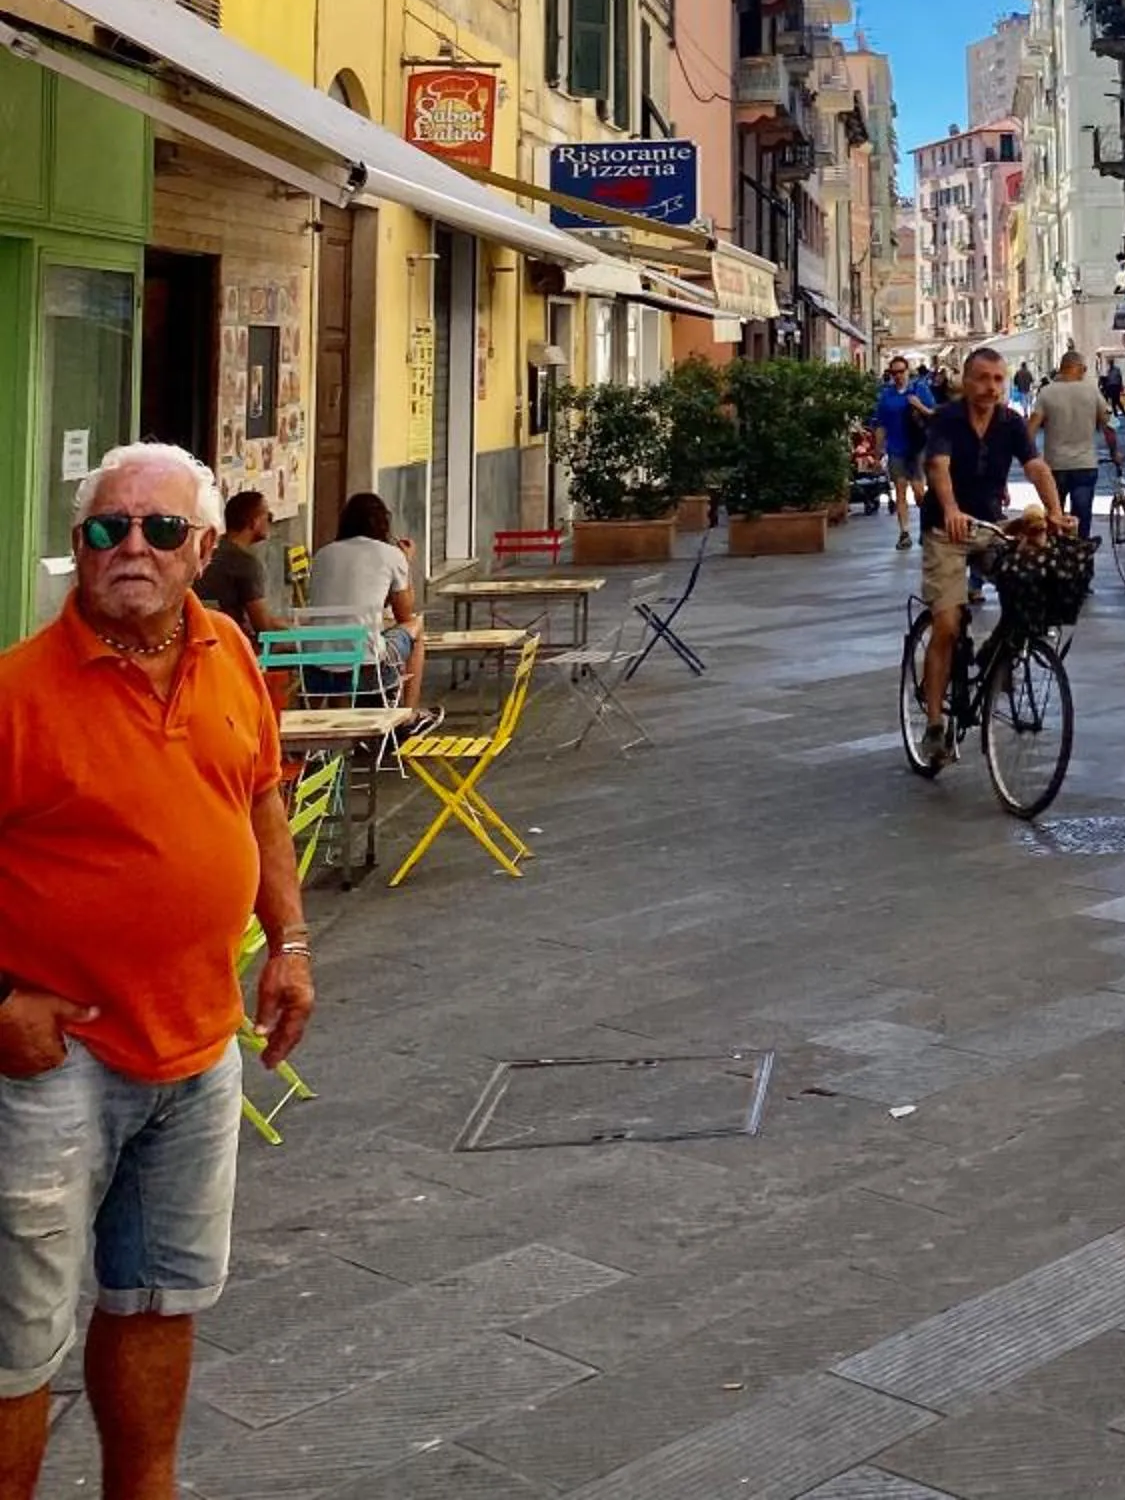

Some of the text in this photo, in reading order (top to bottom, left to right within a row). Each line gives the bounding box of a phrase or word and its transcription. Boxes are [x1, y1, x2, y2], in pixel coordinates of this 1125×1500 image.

[415, 96, 485, 128] Sabor
[412, 116, 488, 142] Latino
[558, 146, 692, 164] Ristorante
[572, 162, 676, 178] Pizzeria
